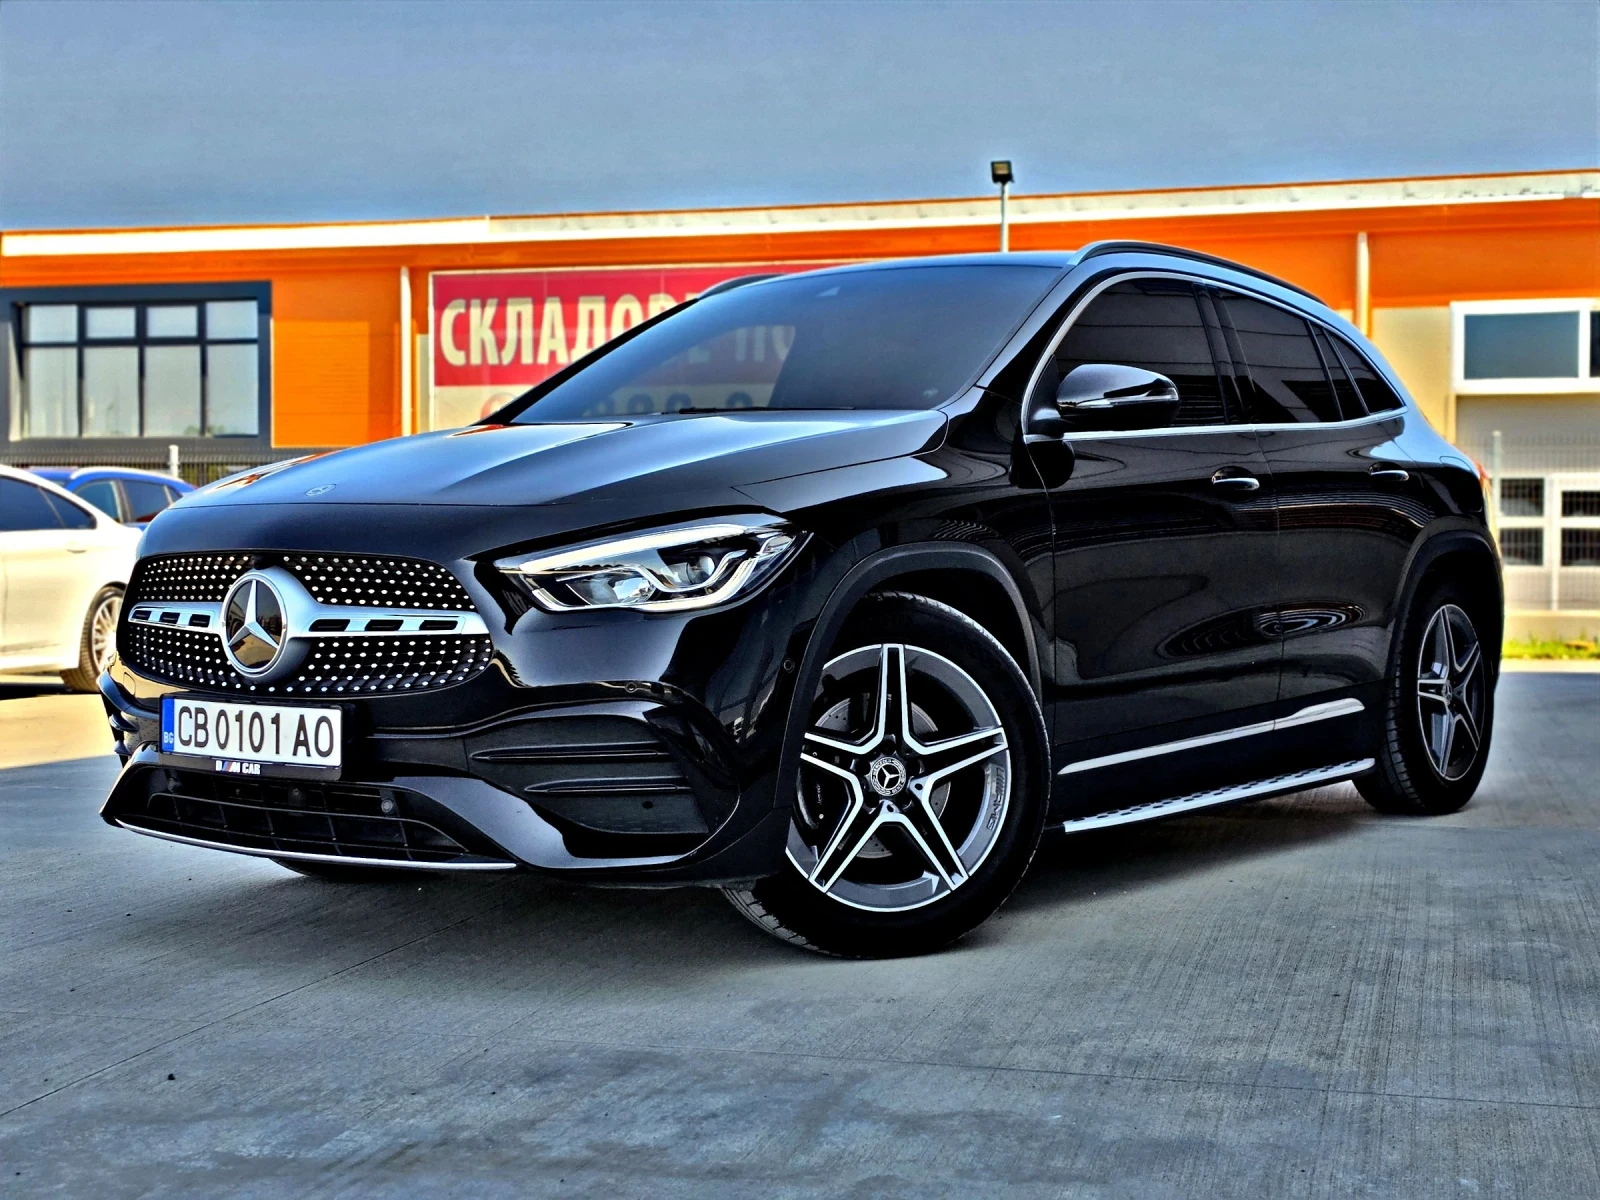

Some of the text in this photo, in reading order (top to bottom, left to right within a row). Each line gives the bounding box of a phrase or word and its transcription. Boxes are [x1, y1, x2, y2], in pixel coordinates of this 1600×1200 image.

[440, 293, 700, 367] СКЛАДО
[163, 731, 175, 744] BG
[242, 762, 261, 775] CAR
